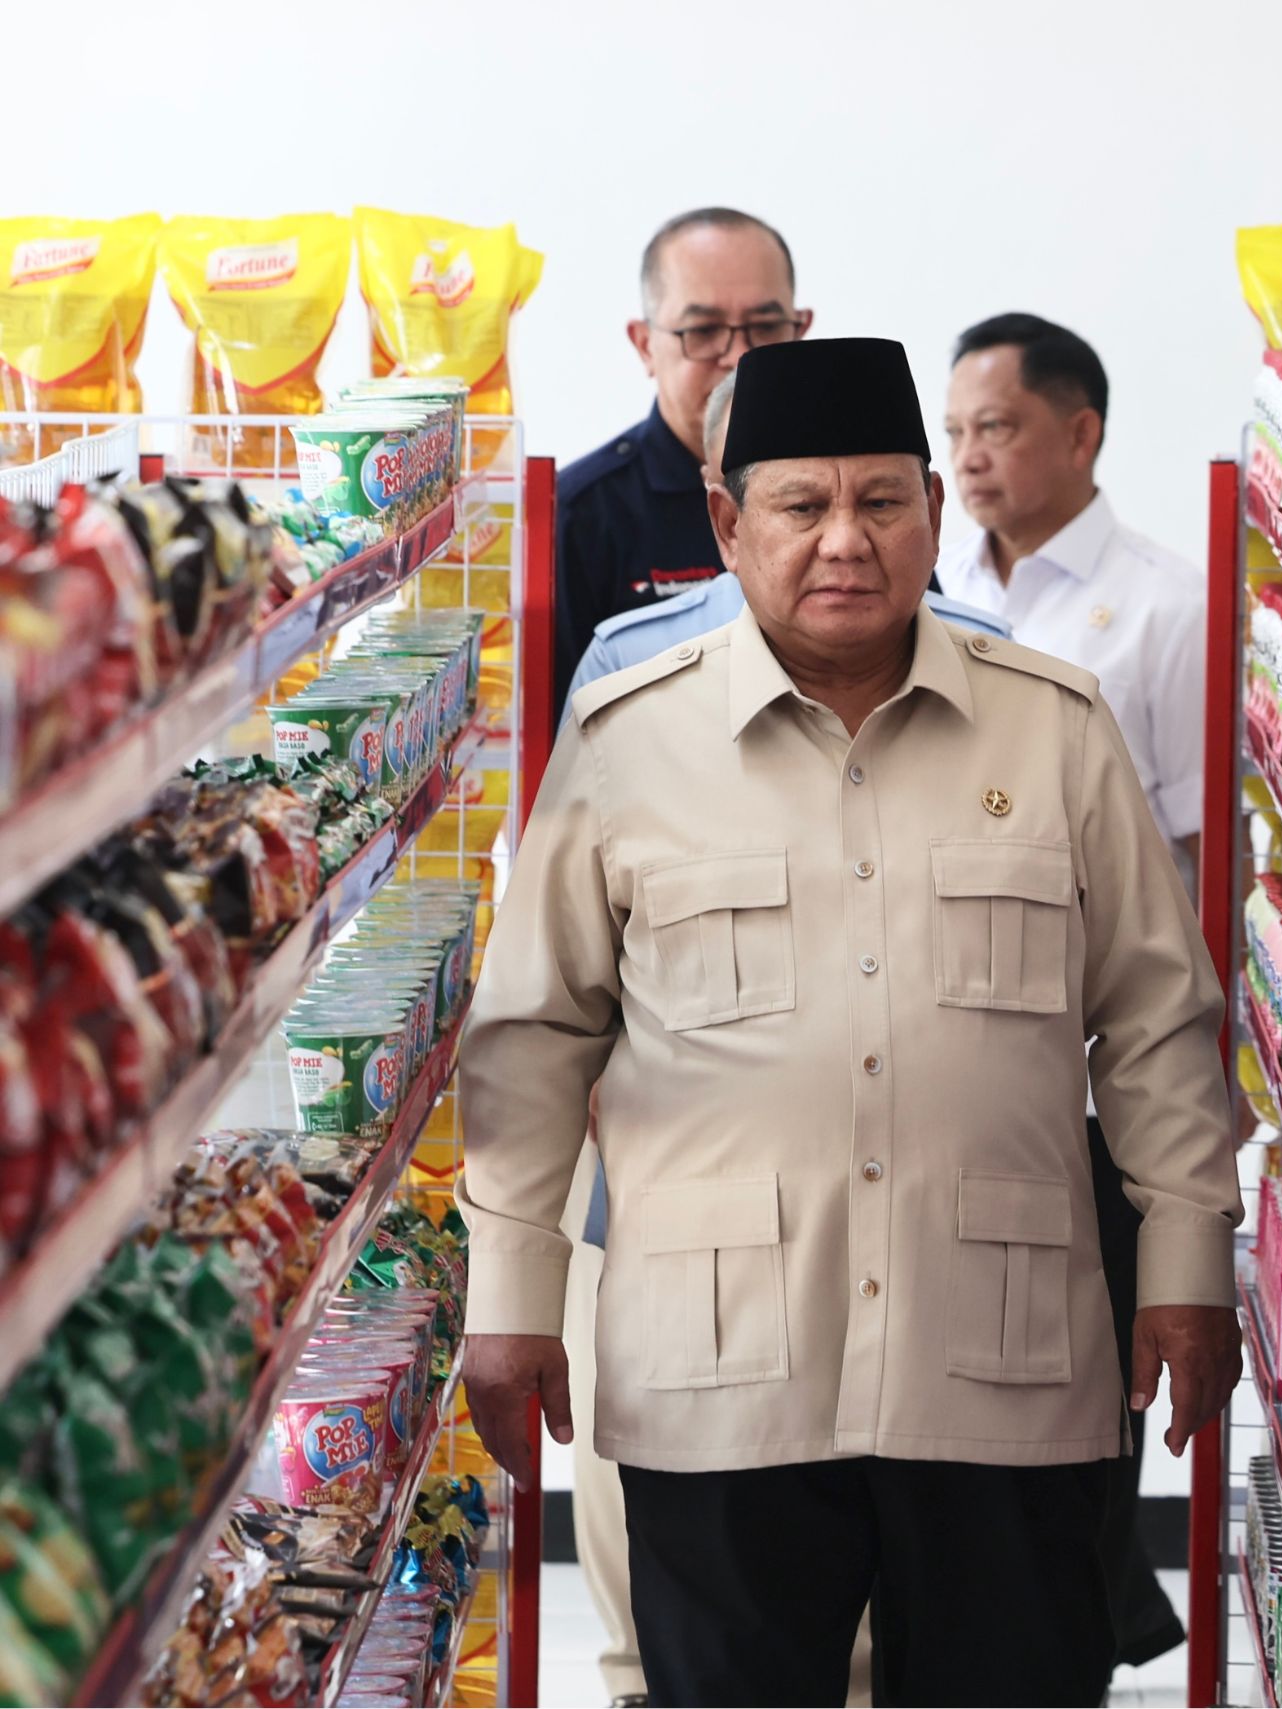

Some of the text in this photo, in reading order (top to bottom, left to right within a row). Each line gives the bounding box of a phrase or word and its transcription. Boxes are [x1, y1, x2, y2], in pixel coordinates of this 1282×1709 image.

[216, 254, 291, 277] Fortune
[303, 1057, 323, 1068] MIE
[315, 1416, 355, 1451] POP
[326, 1430, 369, 1468] MIE
